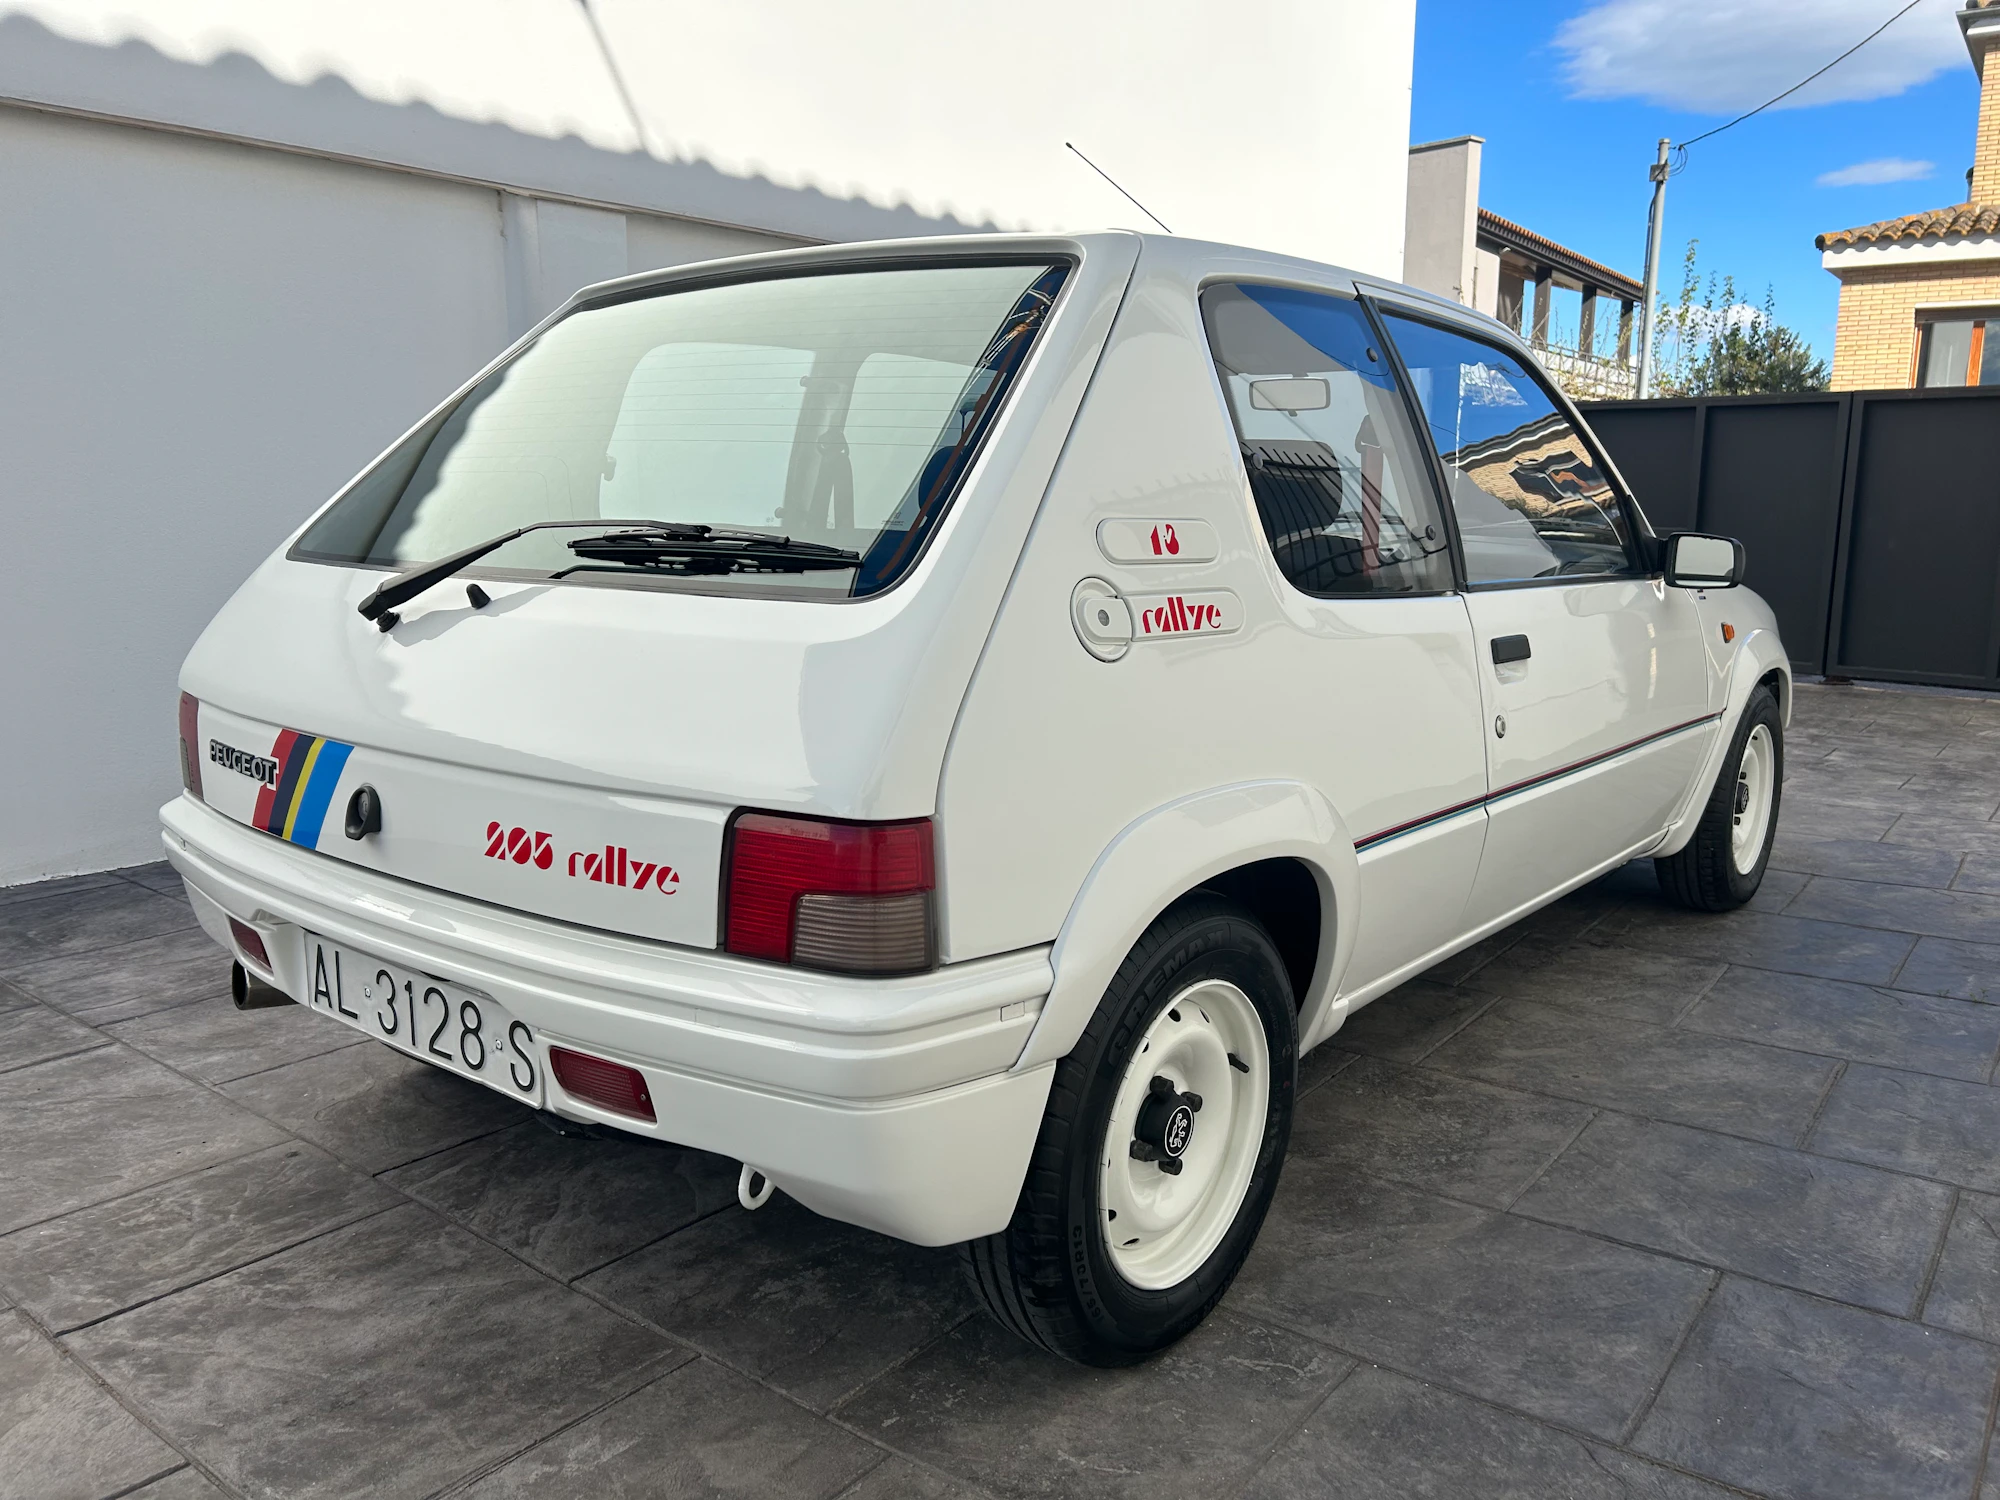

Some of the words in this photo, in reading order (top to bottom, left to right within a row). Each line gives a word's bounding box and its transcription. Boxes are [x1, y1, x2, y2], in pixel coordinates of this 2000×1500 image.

[1142, 596, 1222, 633] rallye
[209, 738, 276, 784] PEUGEOT
[484, 821, 553, 870] 205
[568, 845, 681, 895] rallye
[314, 943, 359, 1021] AL
[376, 969, 486, 1071] 3128
[509, 1020, 535, 1093] S
